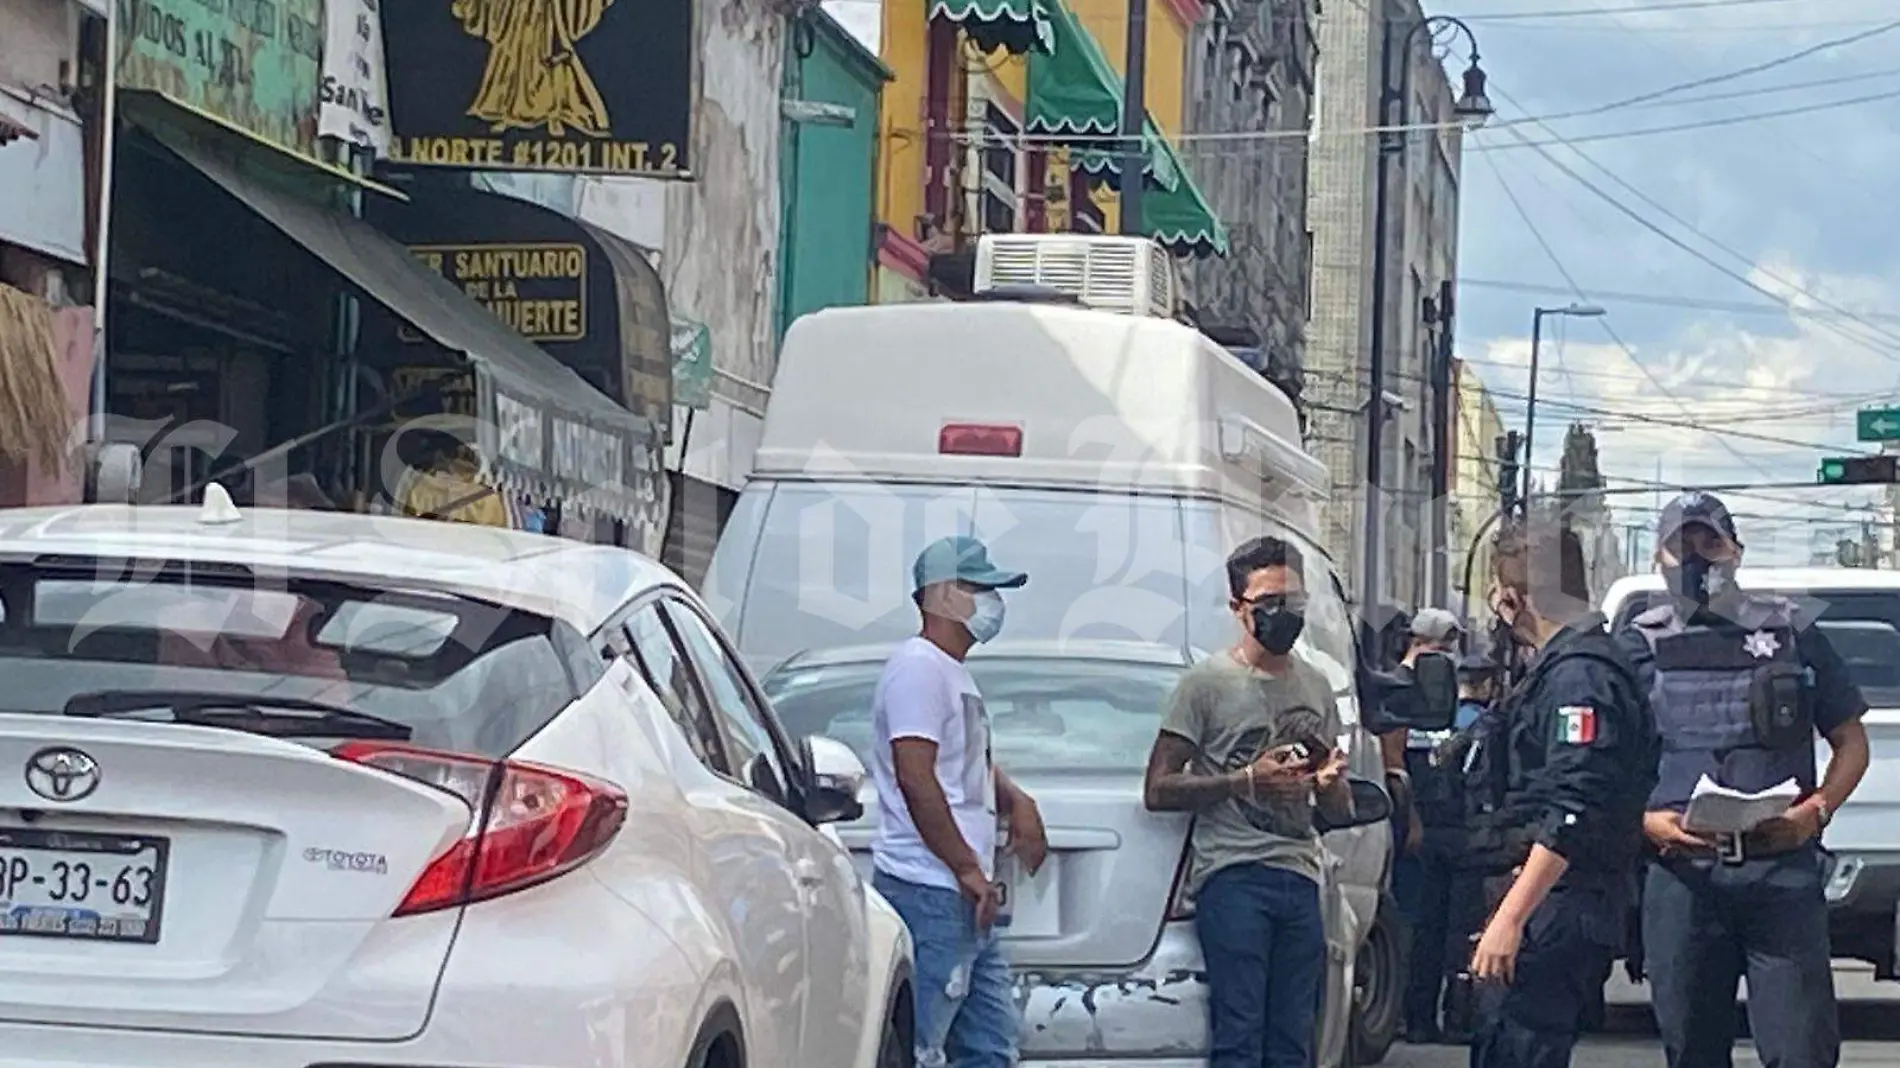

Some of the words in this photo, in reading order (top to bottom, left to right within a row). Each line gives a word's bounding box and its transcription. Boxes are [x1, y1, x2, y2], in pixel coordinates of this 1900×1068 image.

[411, 137, 503, 166] NORTE
[514, 140, 591, 168] #1201
[602, 142, 652, 171] INT.
[660, 143, 677, 171] 2
[455, 251, 581, 278] SANTUARIO
[493, 281, 518, 299] LA
[321, 849, 387, 866] TOYOTA
[0, 856, 152, 906] P-33-63
